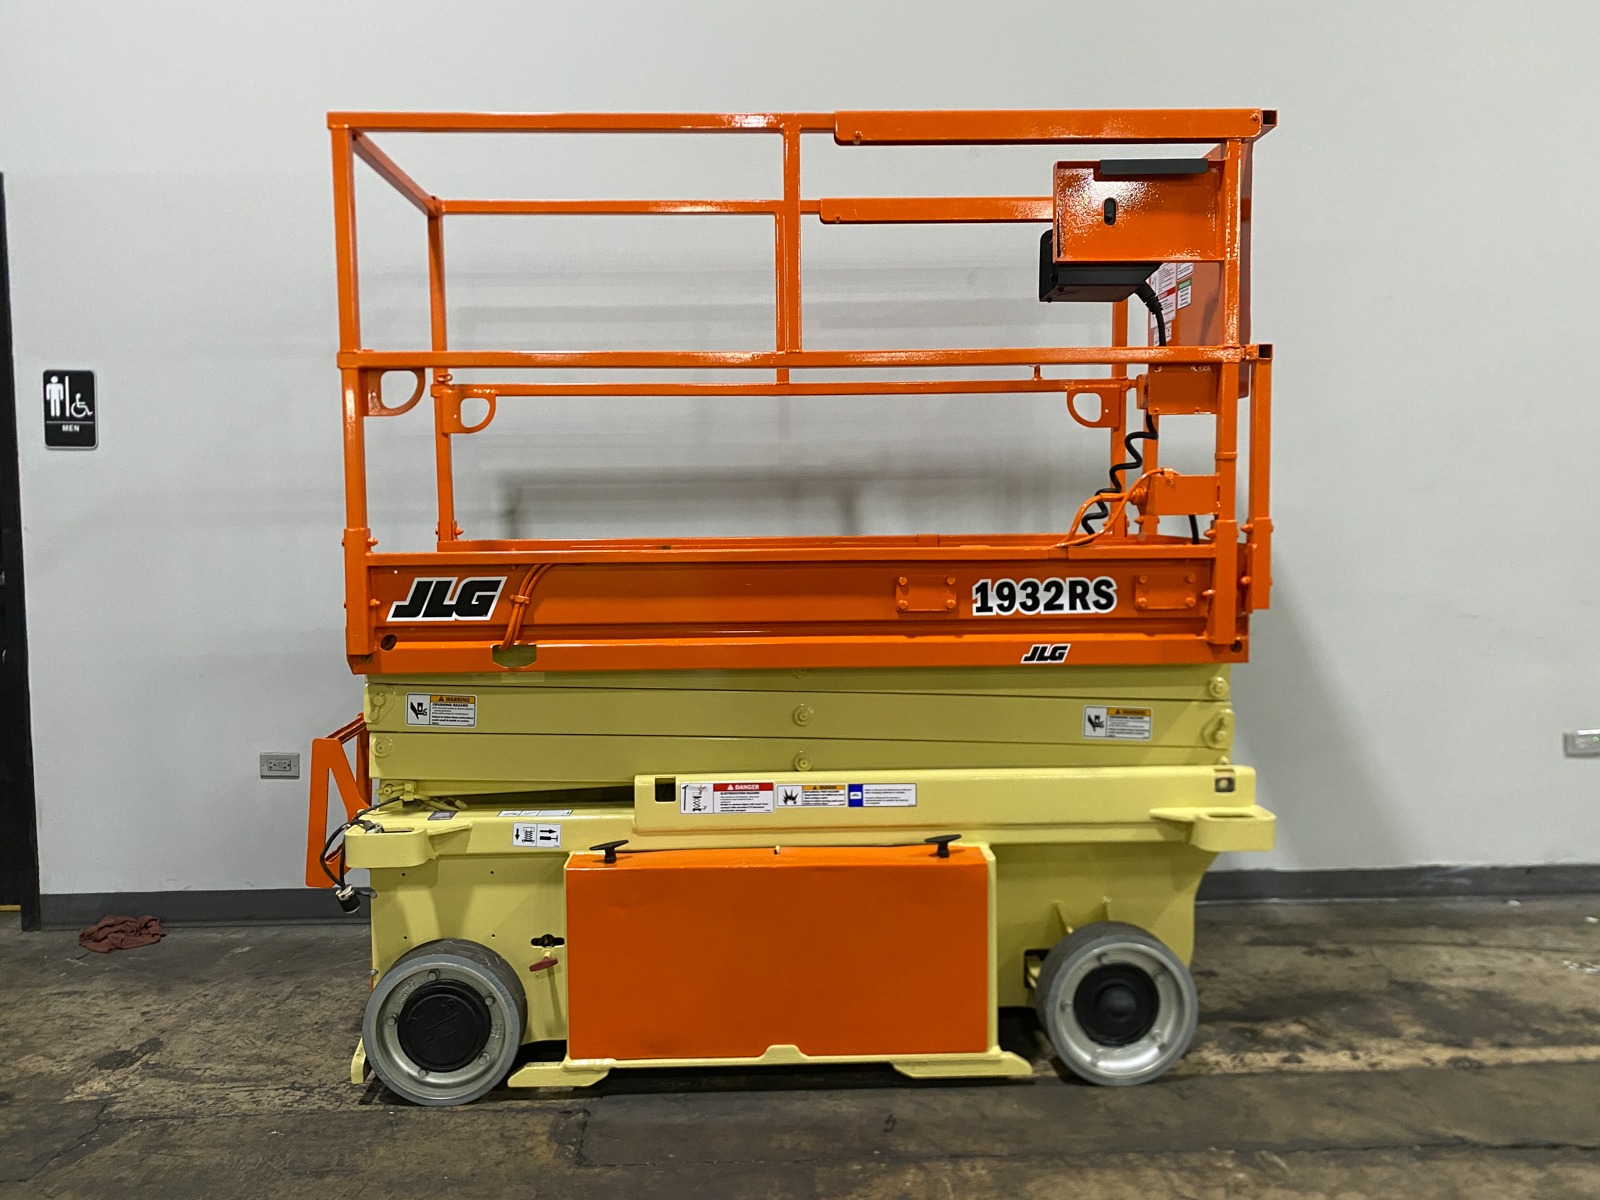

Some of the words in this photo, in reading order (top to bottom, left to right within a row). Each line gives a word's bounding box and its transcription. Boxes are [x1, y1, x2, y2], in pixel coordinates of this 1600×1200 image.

[61, 424, 80, 432] MEN
[388, 578, 505, 620] JLG
[973, 577, 1116, 615] 1932RS
[1021, 645, 1070, 663] JLG
